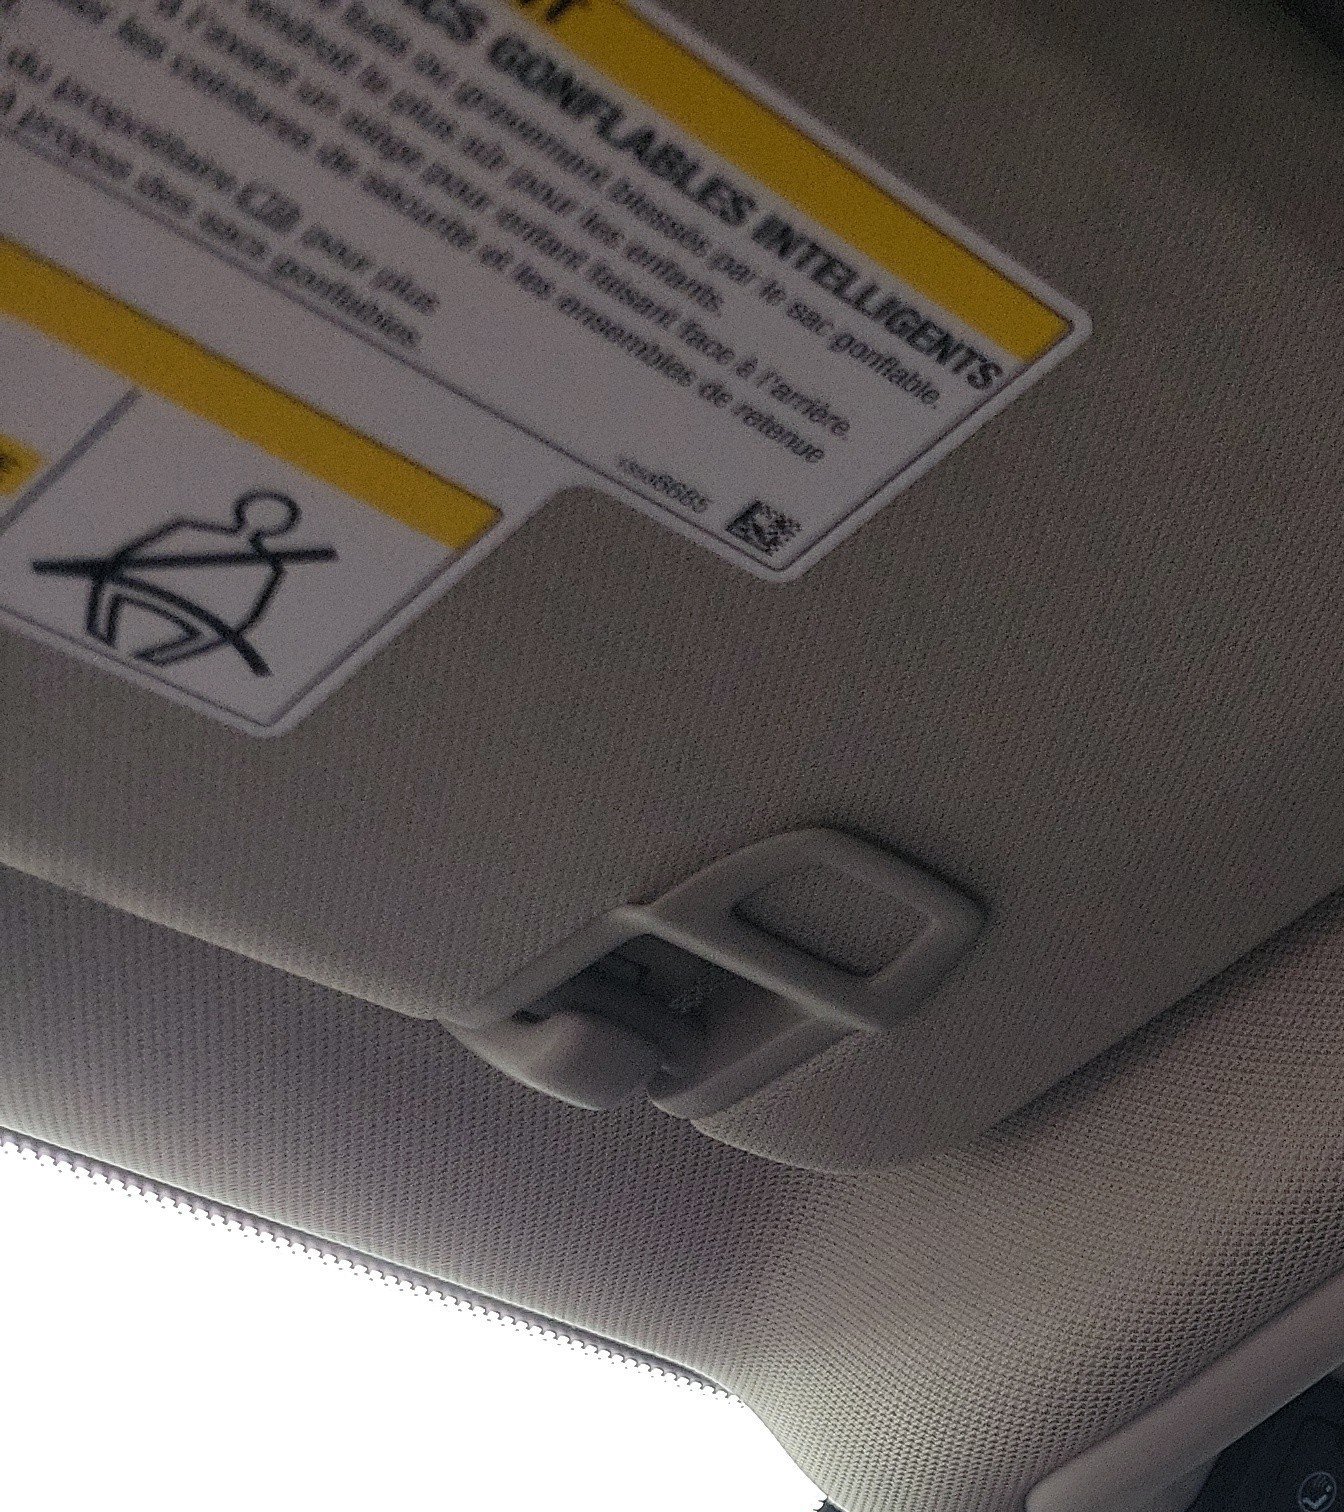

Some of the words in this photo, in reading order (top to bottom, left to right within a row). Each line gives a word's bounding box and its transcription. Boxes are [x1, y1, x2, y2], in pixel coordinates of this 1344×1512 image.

[488, 34, 755, 227] GONFLABLES
[752, 213, 1002, 390] INTELLIGENTS
[758, 278, 788, 306] le
[786, 302, 834, 337] sac
[828, 332, 941, 410] gonflable.
[698, 380, 734, 409] de
[731, 402, 824, 464] retenue
